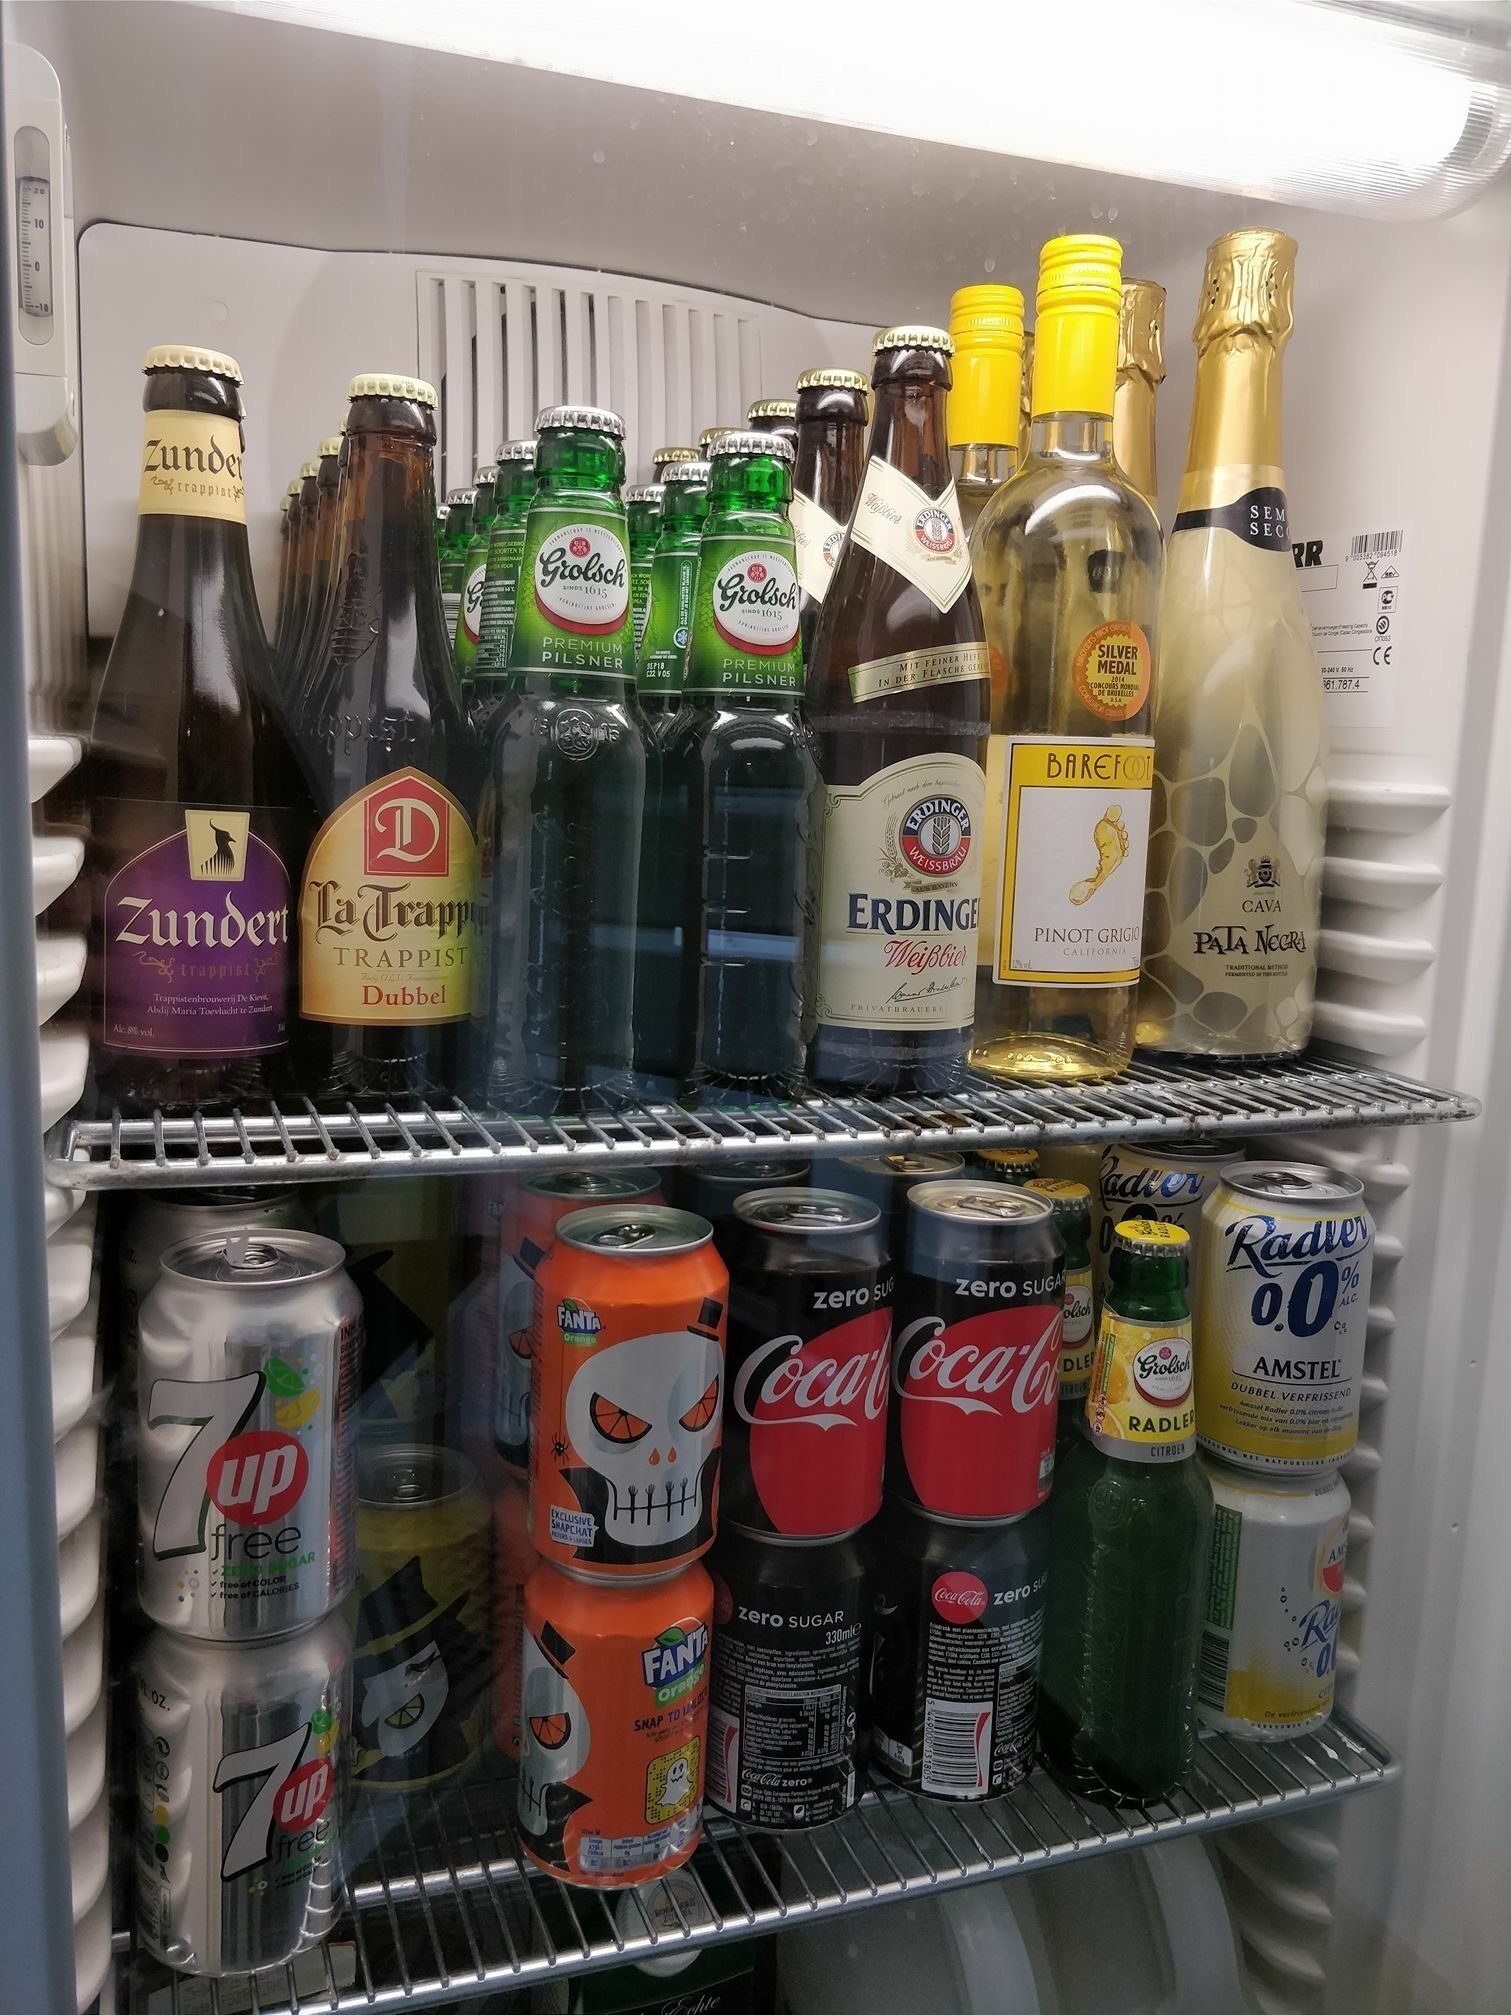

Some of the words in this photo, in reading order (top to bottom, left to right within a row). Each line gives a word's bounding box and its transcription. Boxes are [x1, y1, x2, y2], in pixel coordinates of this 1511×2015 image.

[34, 218, 44, 229] 10
[35, 261, 40, 272] 0
[540, 547, 626, 588] Grolsch
[585, 584, 608, 599] 1615
[717, 573, 798, 612] Grolsch
[761, 608, 783, 621] 1615
[543, 636, 623, 655] PREMIUM
[1097, 644, 1138, 660] SILVER
[542, 651, 623, 669] PILSNER
[723, 658, 796, 673] PREMIUM
[900, 661, 919, 672] MIT
[925, 655, 959, 667] FEINER
[1097, 660, 1137, 675] MEDAL
[722, 672, 796, 687] PILSNER
[896, 673, 916, 683] DER
[922, 664, 965, 679] FLASCHE
[1046, 752, 1151, 781] BAREFOOT
[905, 799, 970, 831] ERDINGER
[373, 797, 440, 863] D
[309, 880, 360, 944] La
[1242, 899, 1282, 913] CAVA
[115, 891, 289, 949] Zundert
[1034, 927, 1093, 944] PINOT
[1097, 926, 1140, 944] GRIGIO
[333, 946, 468, 968] TRAPPIST
[884, 939, 967, 976] Weißbier
[1063, 947, 1127, 956] CALIFORNIA
[179, 961, 250, 986] trappist
[361, 984, 447, 1006] Dubbel
[147, 1005, 169, 1016] Abdij
[171, 1006, 197, 1015] Maria
[199, 1006, 238, 1015] Toevlucht
[248, 1005, 273, 1014] Zundert
[1224, 1214, 1371, 1278] Radler
[813, 1285, 871, 1309] zero
[956, 1275, 1017, 1298] zero
[557, 1305, 601, 1331] FANTA
[563, 1332, 598, 1345] Orange
[1137, 1350, 1191, 1379] Grolsch
[1252, 1356, 1342, 1380] AMSTEL
[1231, 1381, 1276, 1400] DUBBEL
[1282, 1387, 1352, 1402] VERFRISSEND
[1240, 1400, 1263, 1411] Amstel
[1265, 1405, 1288, 1414] Radler
[1128, 1409, 1195, 1433] RADLER
[1150, 1444, 1185, 1457] CITROEN
[148, 1371, 266, 1561] 7
[217, 1444, 299, 1515] up
[551, 1509, 592, 1527] EXCLUSIVE
[551, 1519, 593, 1537] SNAPCHAT
[211, 1523, 302, 1561] free
[219, 1581, 240, 1589] free
[252, 1575, 286, 1587] COLOR
[240, 1591, 251, 1599] of
[252, 1582, 300, 1597] CALORIES
[993, 1584, 1031, 1605] zero
[738, 1606, 784, 1628] zero
[788, 1610, 844, 1628] SUGAR
[643, 1623, 709, 1685] FANTA
[657, 1662, 705, 1702] Orange
[634, 1715, 664, 1732] SNAP
[668, 1709, 680, 1722] TO
[782, 1778, 808, 1787] zero
[213, 1722, 312, 1882] 7
[275, 1820, 330, 1864] free
